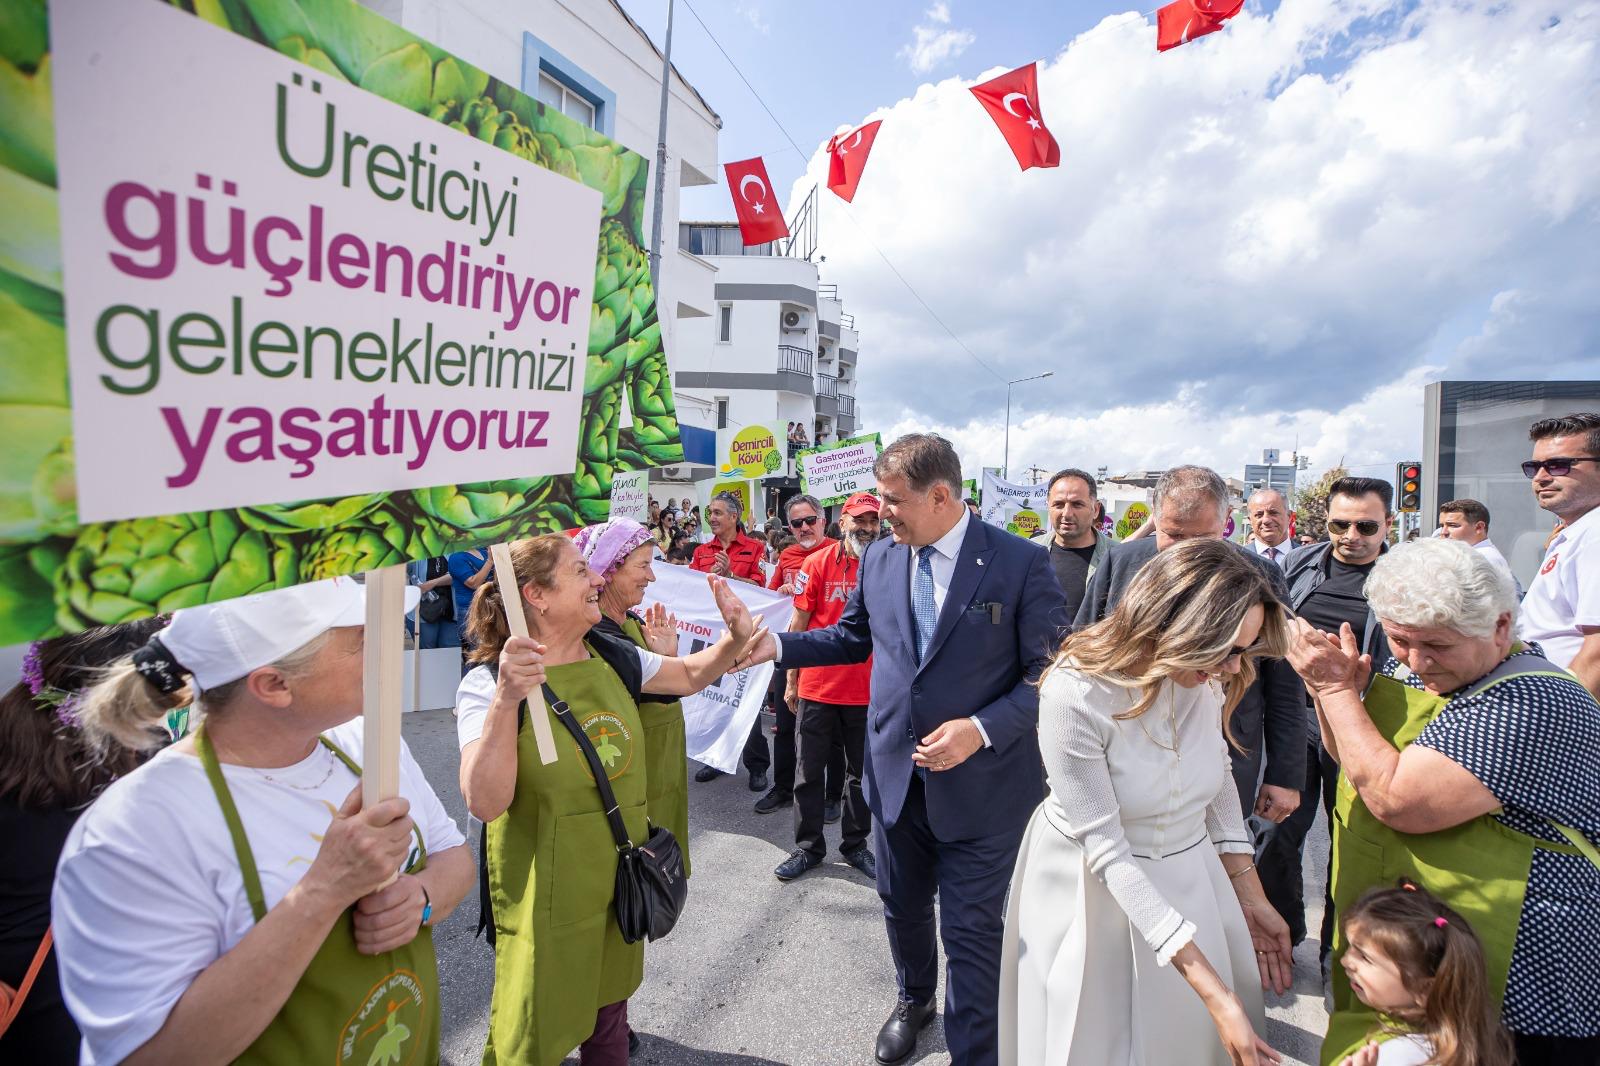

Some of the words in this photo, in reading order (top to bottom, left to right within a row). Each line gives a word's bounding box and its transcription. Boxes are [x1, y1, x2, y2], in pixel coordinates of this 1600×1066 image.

[275, 71, 518, 247] Üreticiyi
[103, 172, 581, 331] güçlendiriyor
[93, 296, 577, 395] geleneklerimizi
[160, 393, 550, 488] yaşatıyoruz
[732, 435, 774, 453] Demircili
[738, 450, 762, 465] Köyü
[815, 446, 865, 464] Gastronomi
[809, 462, 842, 476] Turizmin
[843, 455, 875, 469] merkezi
[808, 472, 837, 487] Ege'nin
[838, 464, 876, 481] gözbebe
[834, 479, 858, 493] Urla
[996, 485, 1031, 498] BARBAROS
[1012, 514, 1039, 523] Barbaros
[1127, 506, 1148, 520] Özbek
